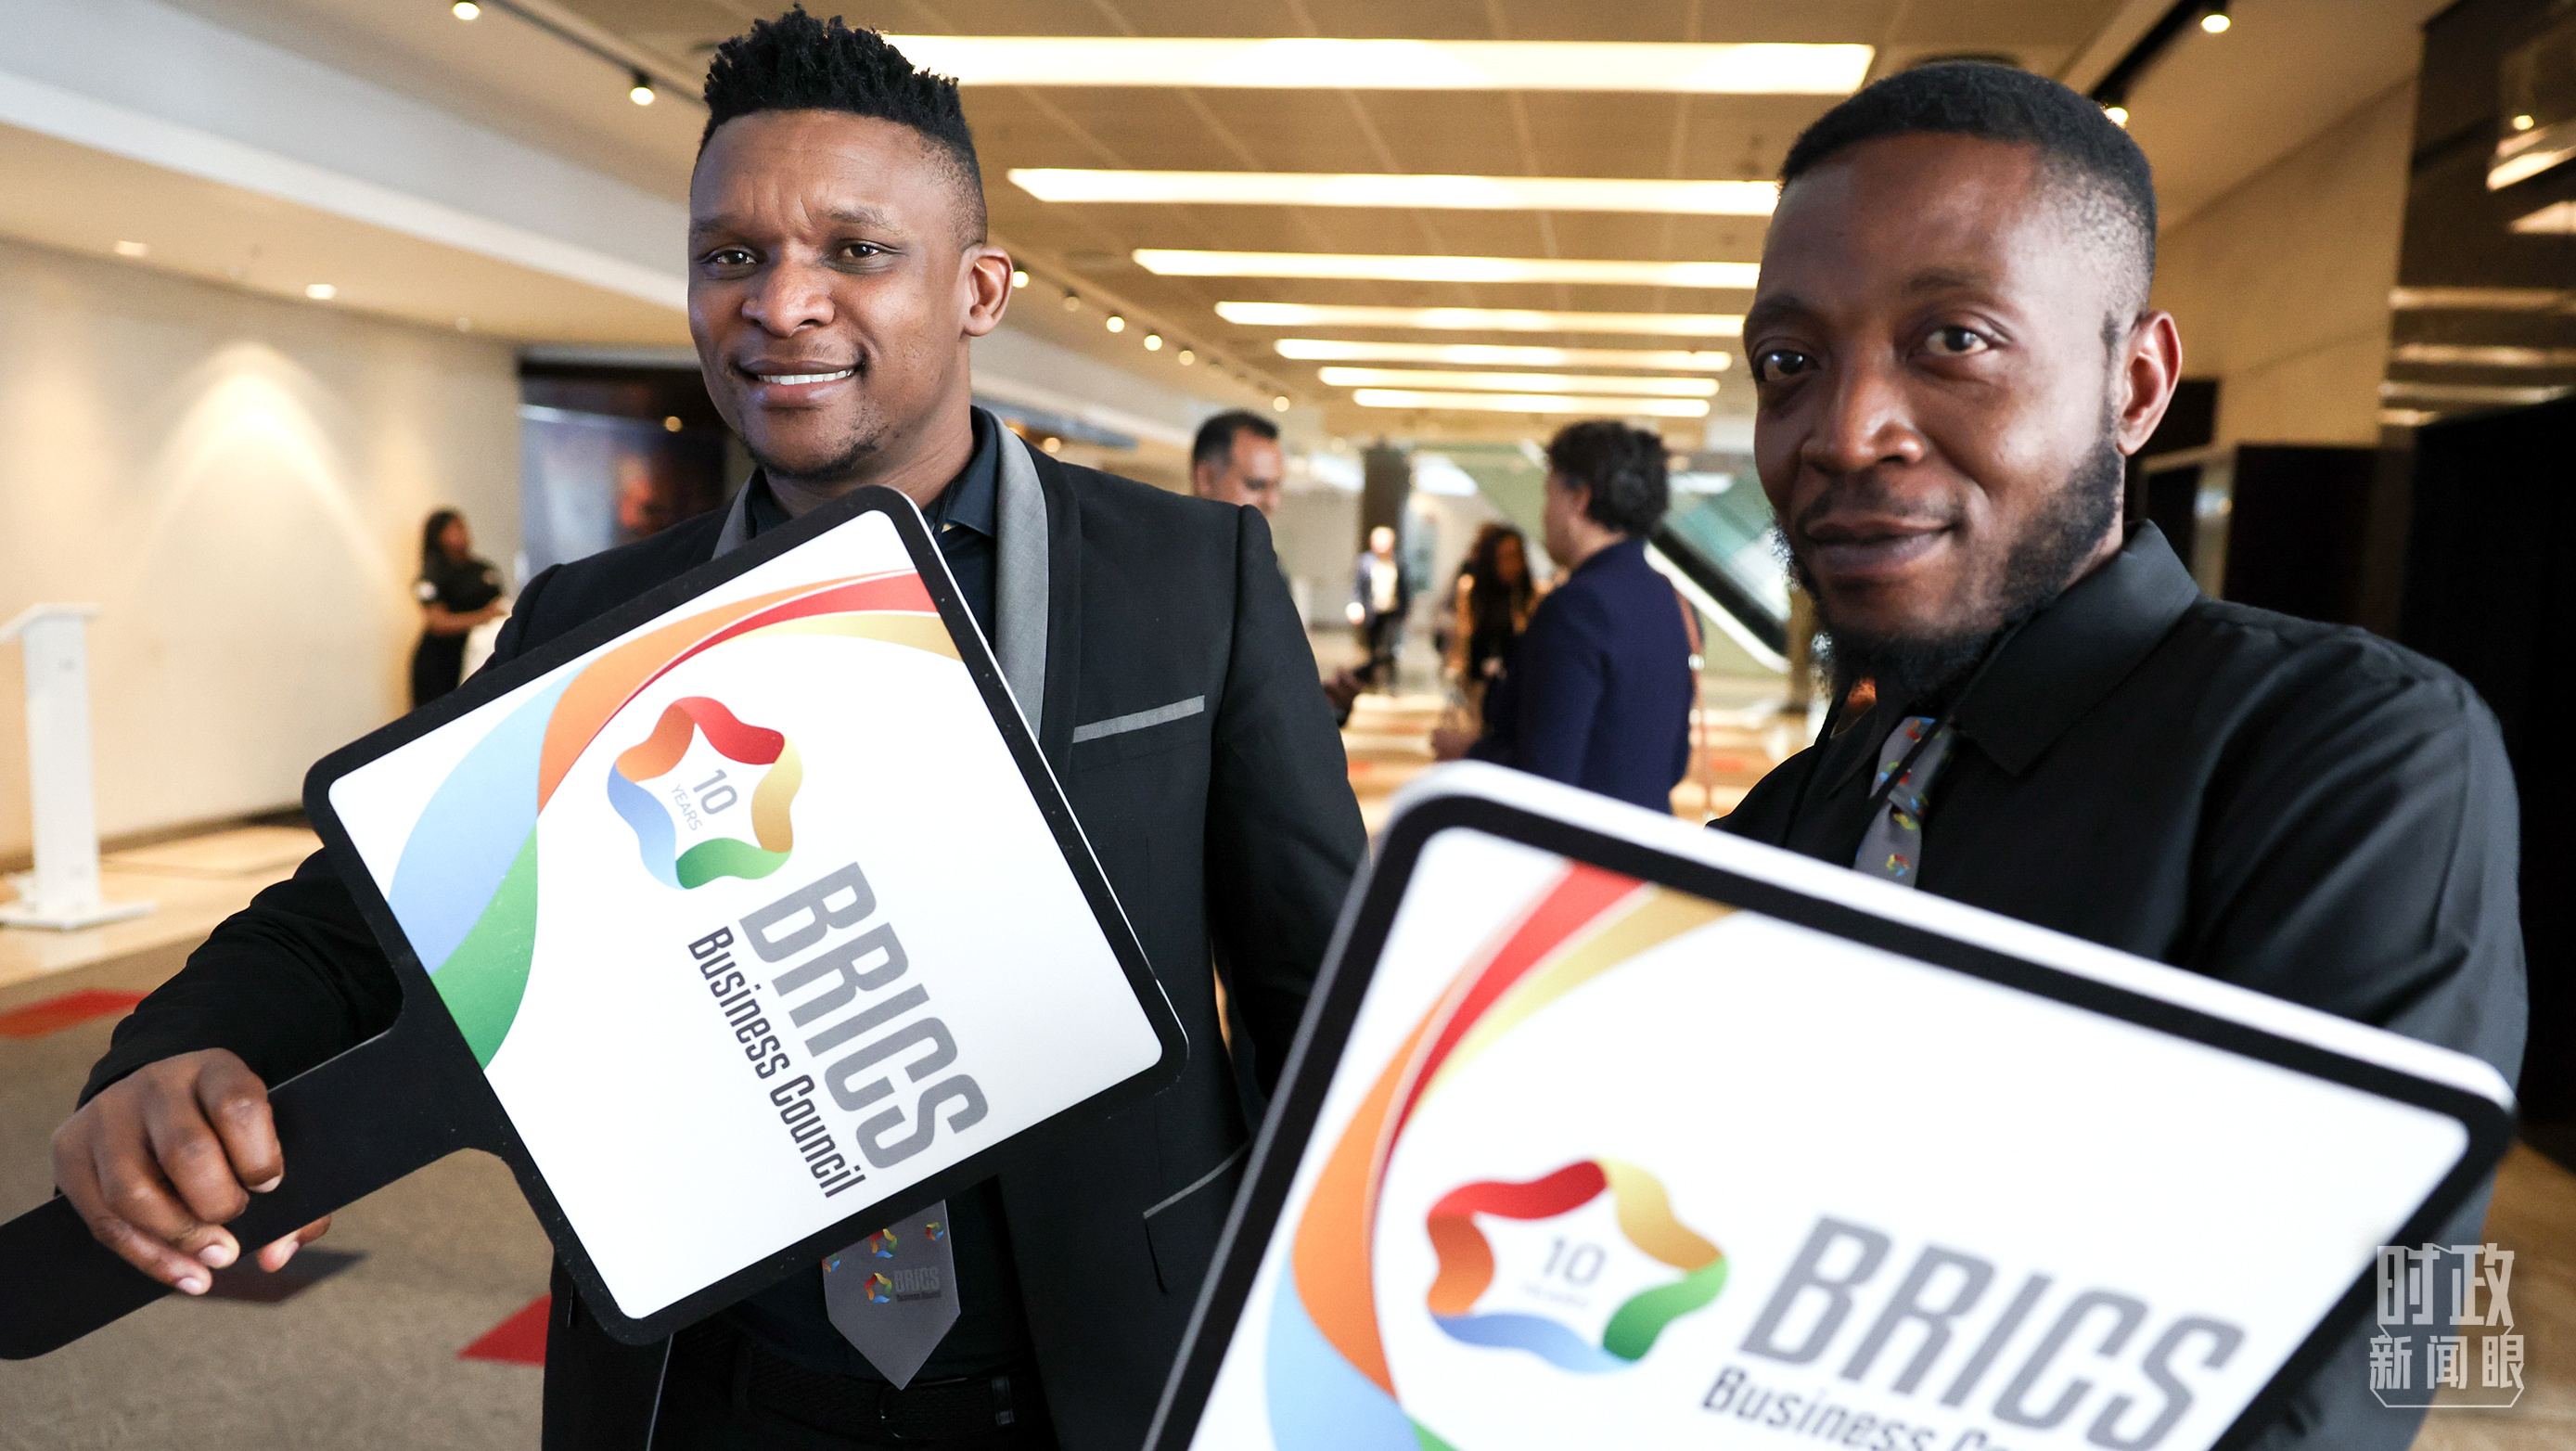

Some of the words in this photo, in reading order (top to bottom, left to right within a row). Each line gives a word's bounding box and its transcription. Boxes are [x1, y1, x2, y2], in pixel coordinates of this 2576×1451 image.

[669, 782, 703, 832] YEARS
[693, 768, 738, 816] 10
[687, 926, 791, 1081] Business
[769, 1073, 867, 1199] Council
[738, 861, 989, 1171] BRICS
[1543, 1235, 1608, 1287] 10
[1738, 1213, 2246, 1451] BRICS
